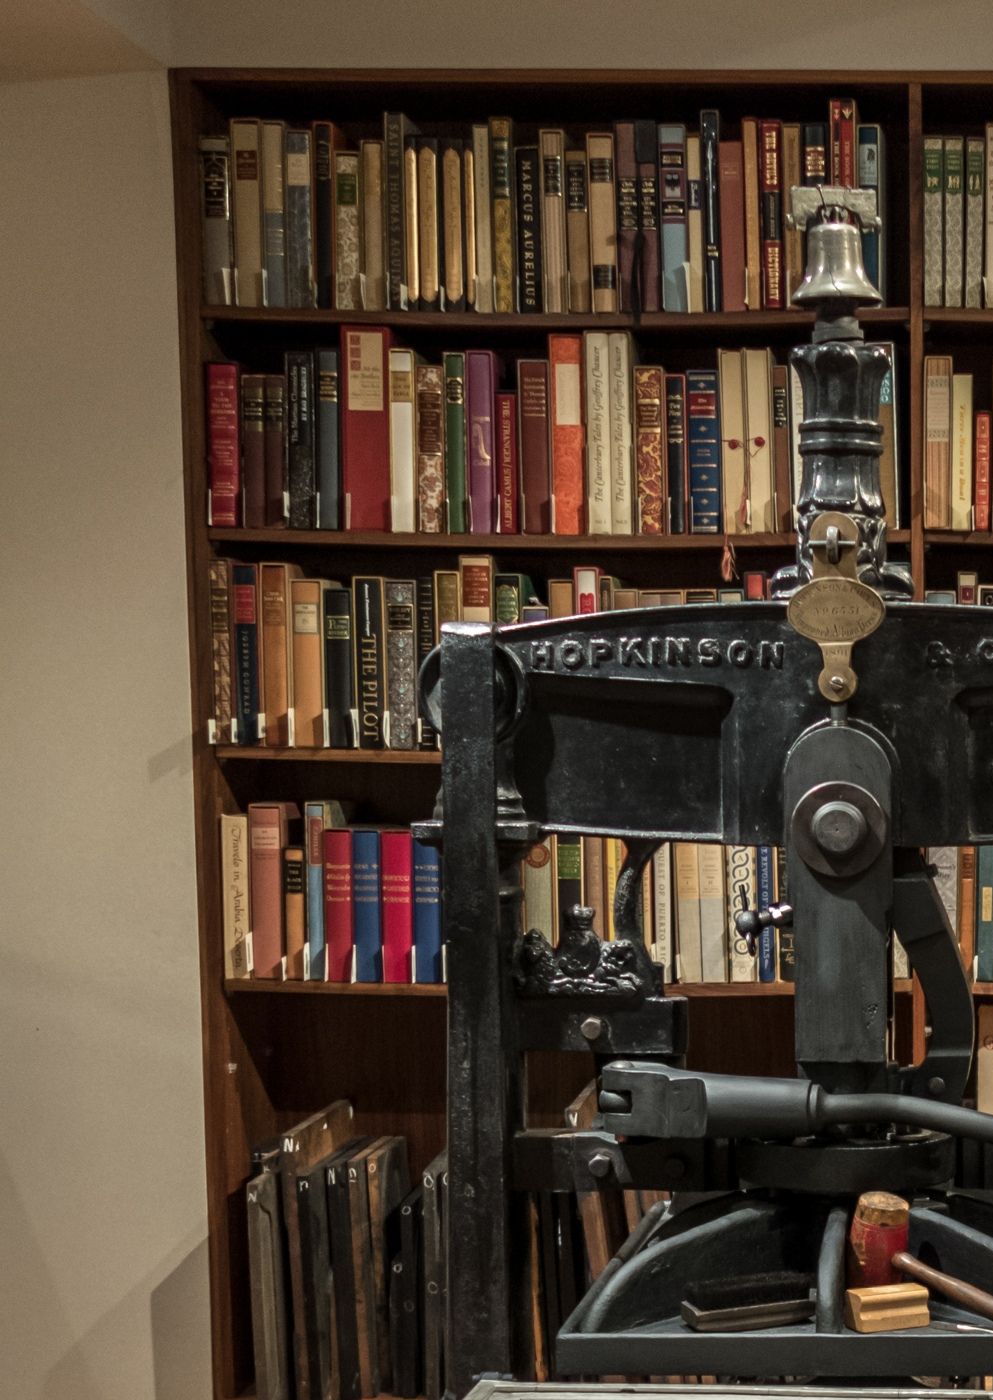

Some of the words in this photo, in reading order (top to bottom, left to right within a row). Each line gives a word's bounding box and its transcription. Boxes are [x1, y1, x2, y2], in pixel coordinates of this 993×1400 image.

[521, 160, 534, 223] MARCUS
[523, 229, 537, 306] AURELIUS
[592, 380, 603, 411] Geoffrey
[614, 380, 625, 411] Geoffrey
[592, 412, 603, 421] by
[593, 423, 603, 442] Tales
[614, 412, 624, 421] by
[614, 423, 624, 442] Tales
[593, 444, 604, 486] Canterbury
[614, 444, 625, 486] Canterbury
[594, 488, 603, 502] The
[615, 488, 624, 502] The
[361, 634, 378, 675] THE
[529, 636, 786, 671] HOPKINSON
[926, 640, 954, 668] &
[361, 681, 379, 741] PILOT
[230, 824, 243, 867] Travels
[232, 871, 241, 882] in
[761, 855, 771, 890] REVOLT
[230, 886, 244, 922] Arabia
[658, 884, 667, 897] OF
[761, 893, 770, 904] OF
[658, 903, 667, 941] PUERTO
